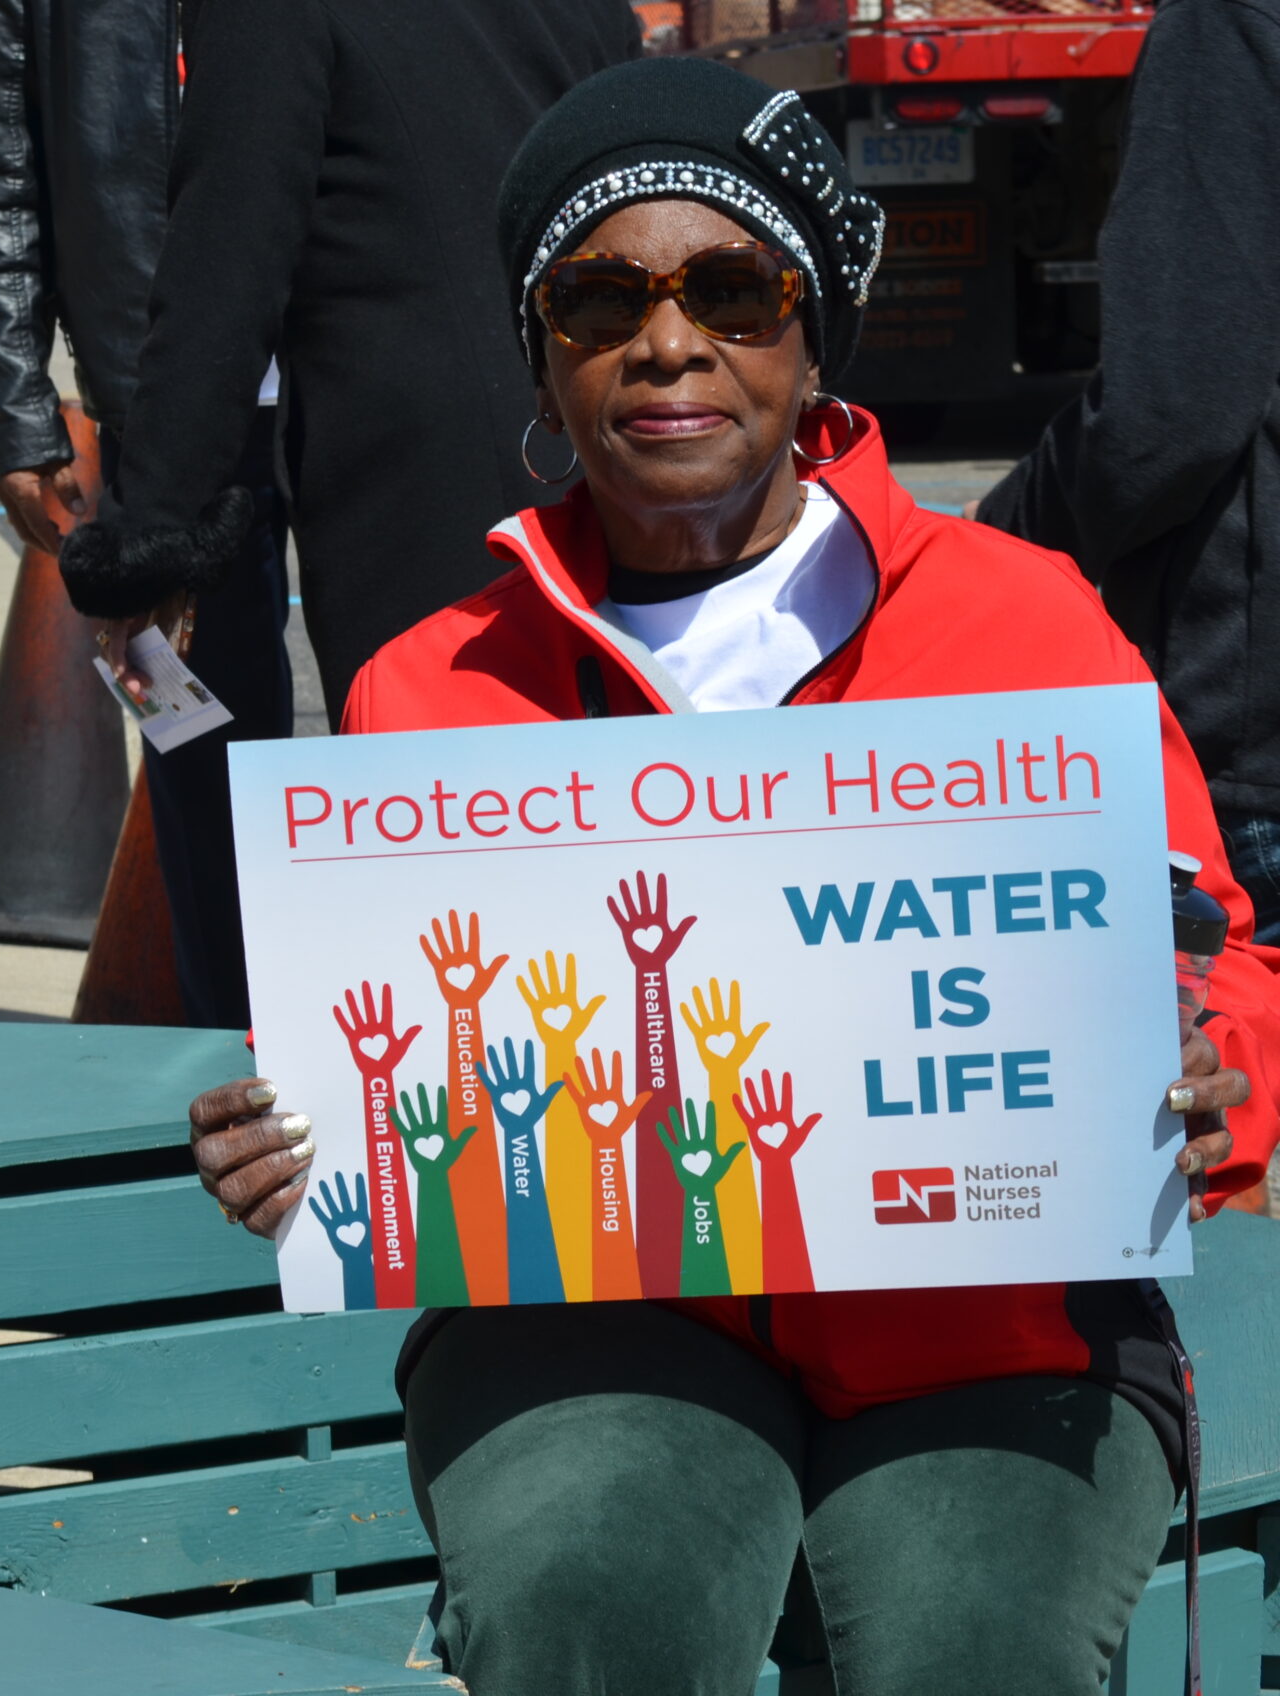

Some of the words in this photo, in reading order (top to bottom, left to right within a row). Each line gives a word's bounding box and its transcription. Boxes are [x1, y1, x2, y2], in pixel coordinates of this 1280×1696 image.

[284, 770, 598, 849] Protect
[630, 761, 790, 828] Our
[824, 735, 1101, 816] Health
[783, 868, 1110, 946] WATER
[642, 971, 666, 1090] Healthcare
[911, 966, 991, 1030] IS
[453, 1007, 478, 1116] Education
[864, 1049, 1054, 1117] LIFE
[369, 1077, 389, 1135] Clean
[510, 1135, 530, 1198] Water
[599, 1147, 620, 1233] Housing
[964, 1160, 1059, 1182] National
[965, 1183, 1042, 1203] Nurses
[376, 1141, 405, 1270] Environment
[692, 1195, 713, 1246] Jobs
[966, 1201, 1041, 1222] United
